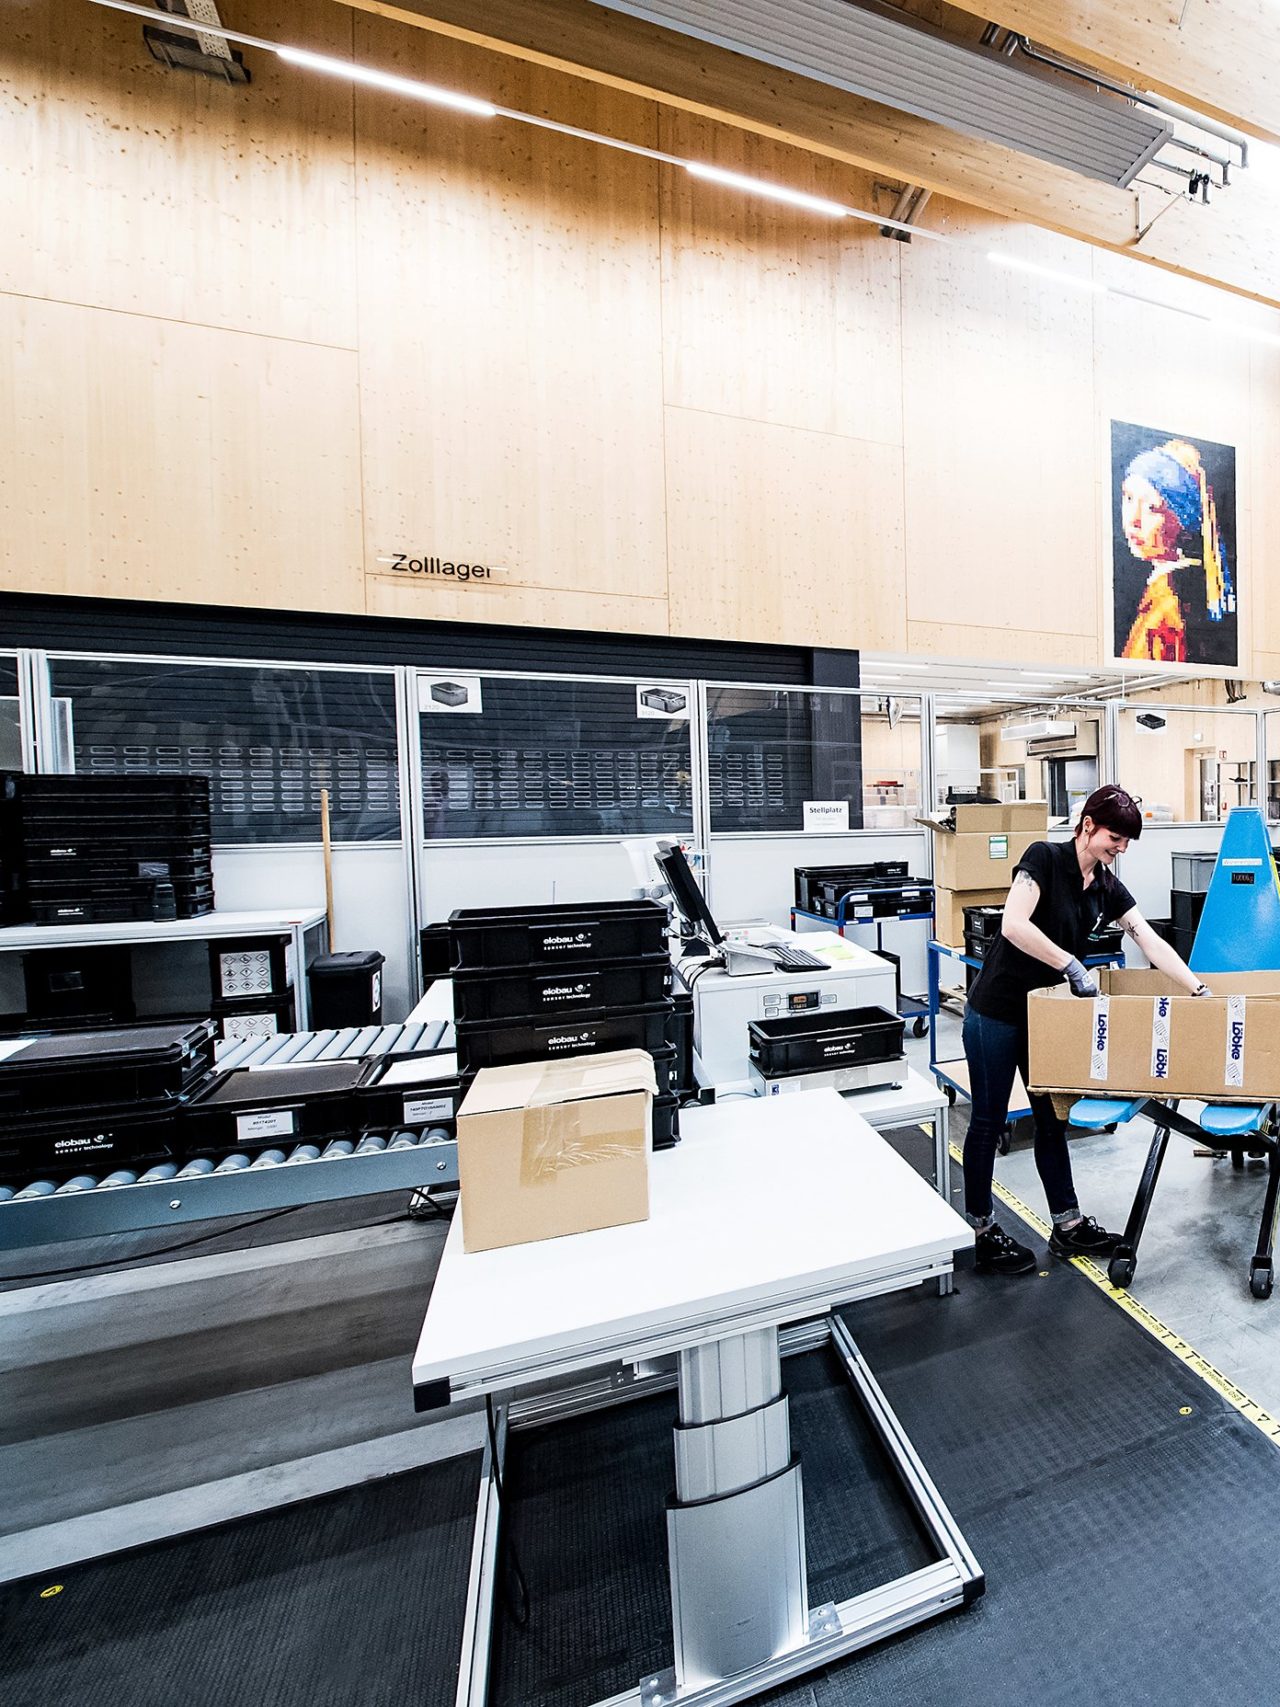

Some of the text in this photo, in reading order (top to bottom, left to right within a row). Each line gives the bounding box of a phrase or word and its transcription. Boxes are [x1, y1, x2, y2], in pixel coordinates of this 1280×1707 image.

[543, 936, 573, 945] elobau
[542, 986, 572, 996] elobau
[548, 1036, 578, 1044] elobau
[1231, 1021, 1243, 1060] Löbke
[54, 1138, 90, 1148] elobau
[1195, 1361, 1242, 1402] ESD Protected Area
